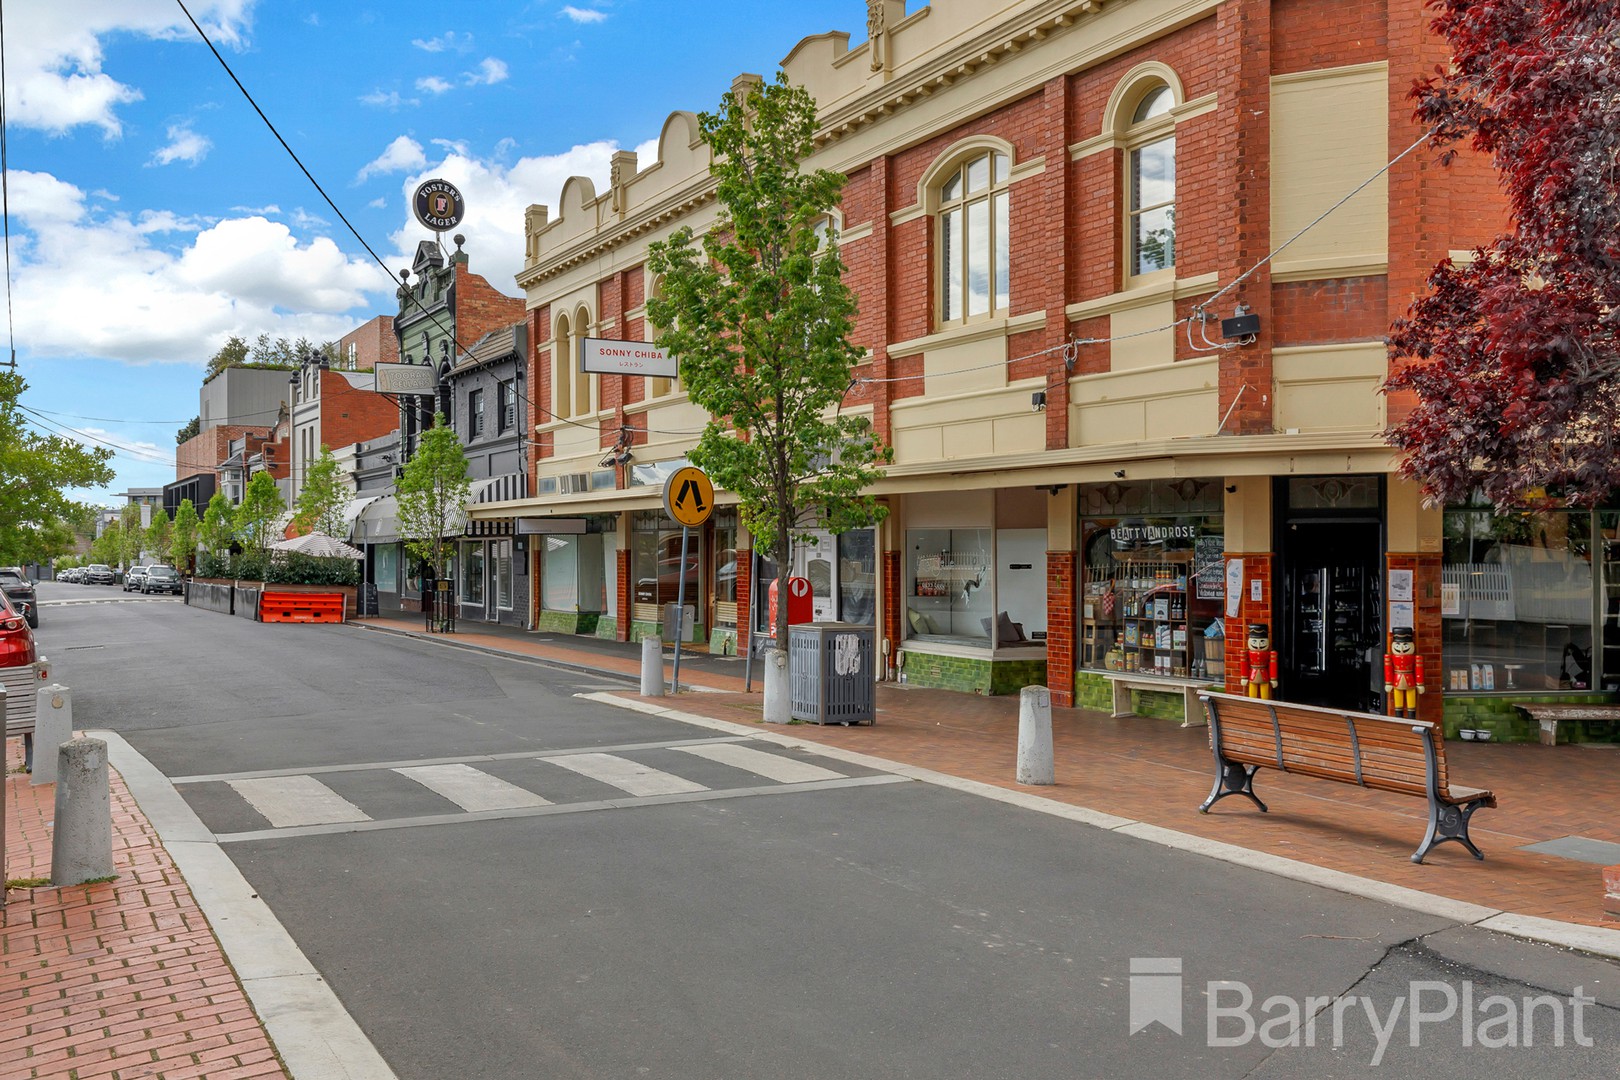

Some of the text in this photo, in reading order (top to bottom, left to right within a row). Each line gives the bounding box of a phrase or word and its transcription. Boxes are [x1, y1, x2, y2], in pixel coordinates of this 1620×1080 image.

[424, 213, 457, 226] LAGER
[600, 348, 663, 360] SONNY CHIBA
[390, 371, 430, 380] TOORAK
[392, 380, 430, 388] CELLARS
